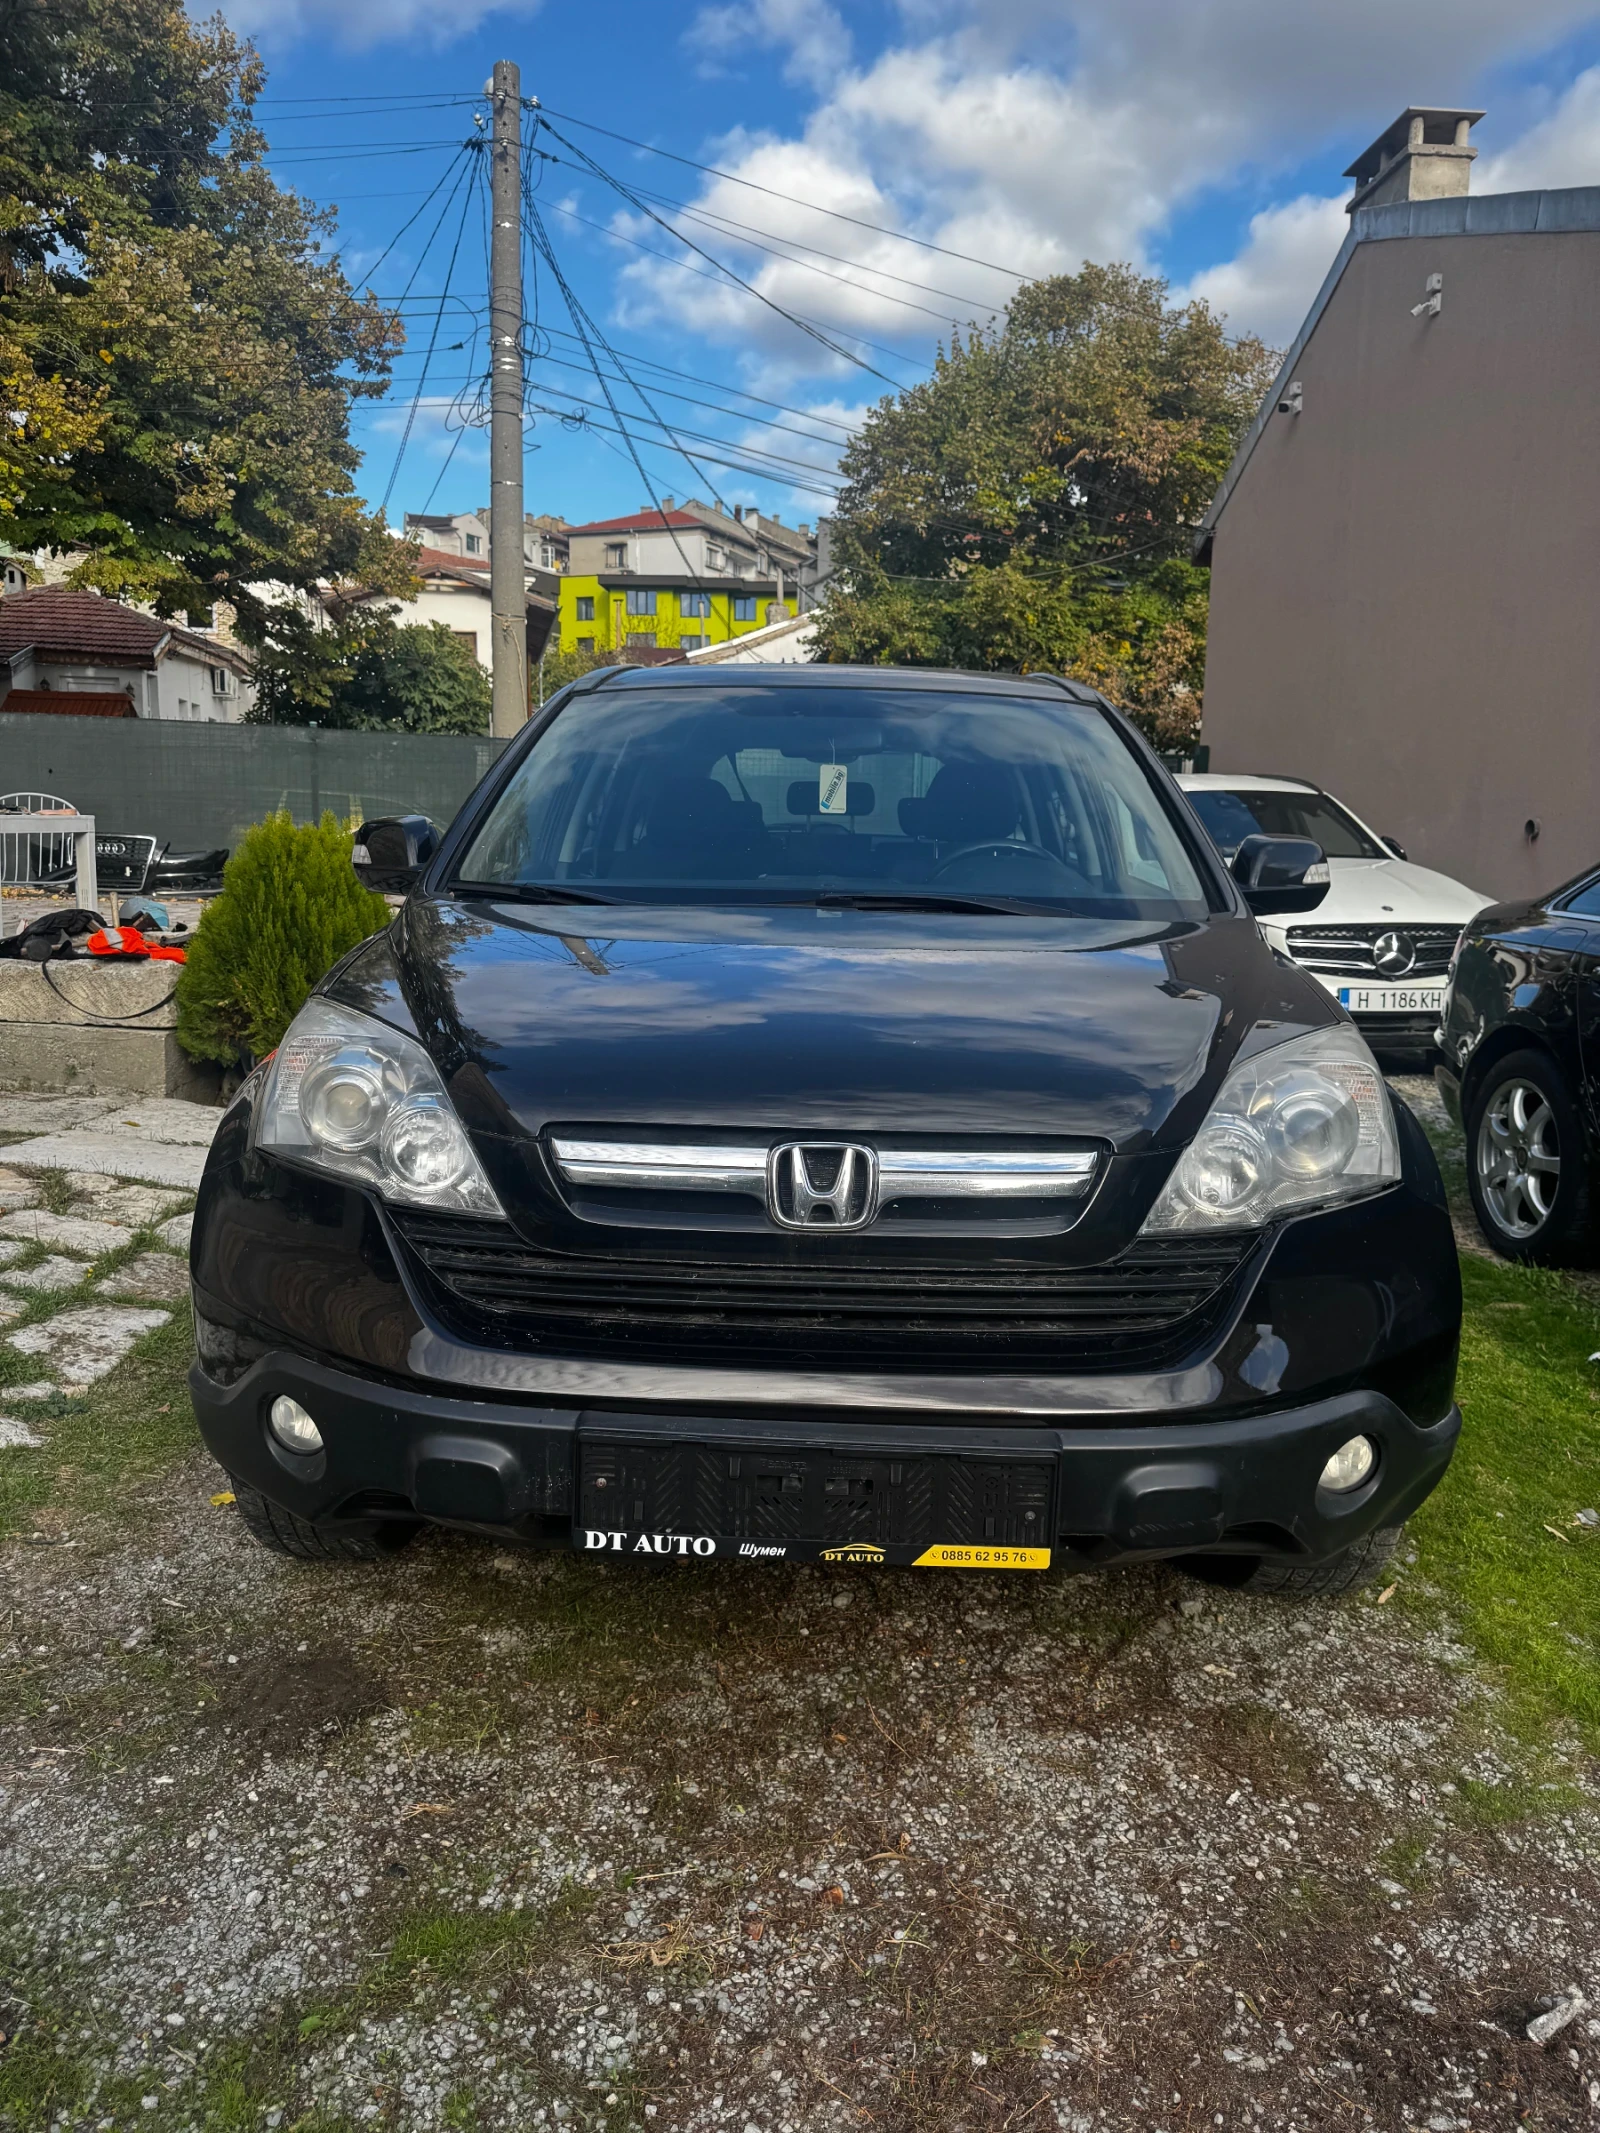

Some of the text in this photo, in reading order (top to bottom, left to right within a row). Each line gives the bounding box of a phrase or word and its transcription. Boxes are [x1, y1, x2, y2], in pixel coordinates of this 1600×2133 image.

[824, 771, 843, 803] mobile.bg
[1358, 992, 1369, 1009] H
[1380, 992, 1417, 1009] 1186
[1420, 992, 1441, 1009] KH
[584, 1530, 717, 1556] DT AUTO
[738, 1543, 786, 1558] Шумен
[824, 1552, 885, 1563] DT AUTO
[941, 1550, 1027, 1563] 0885 62 95 76
